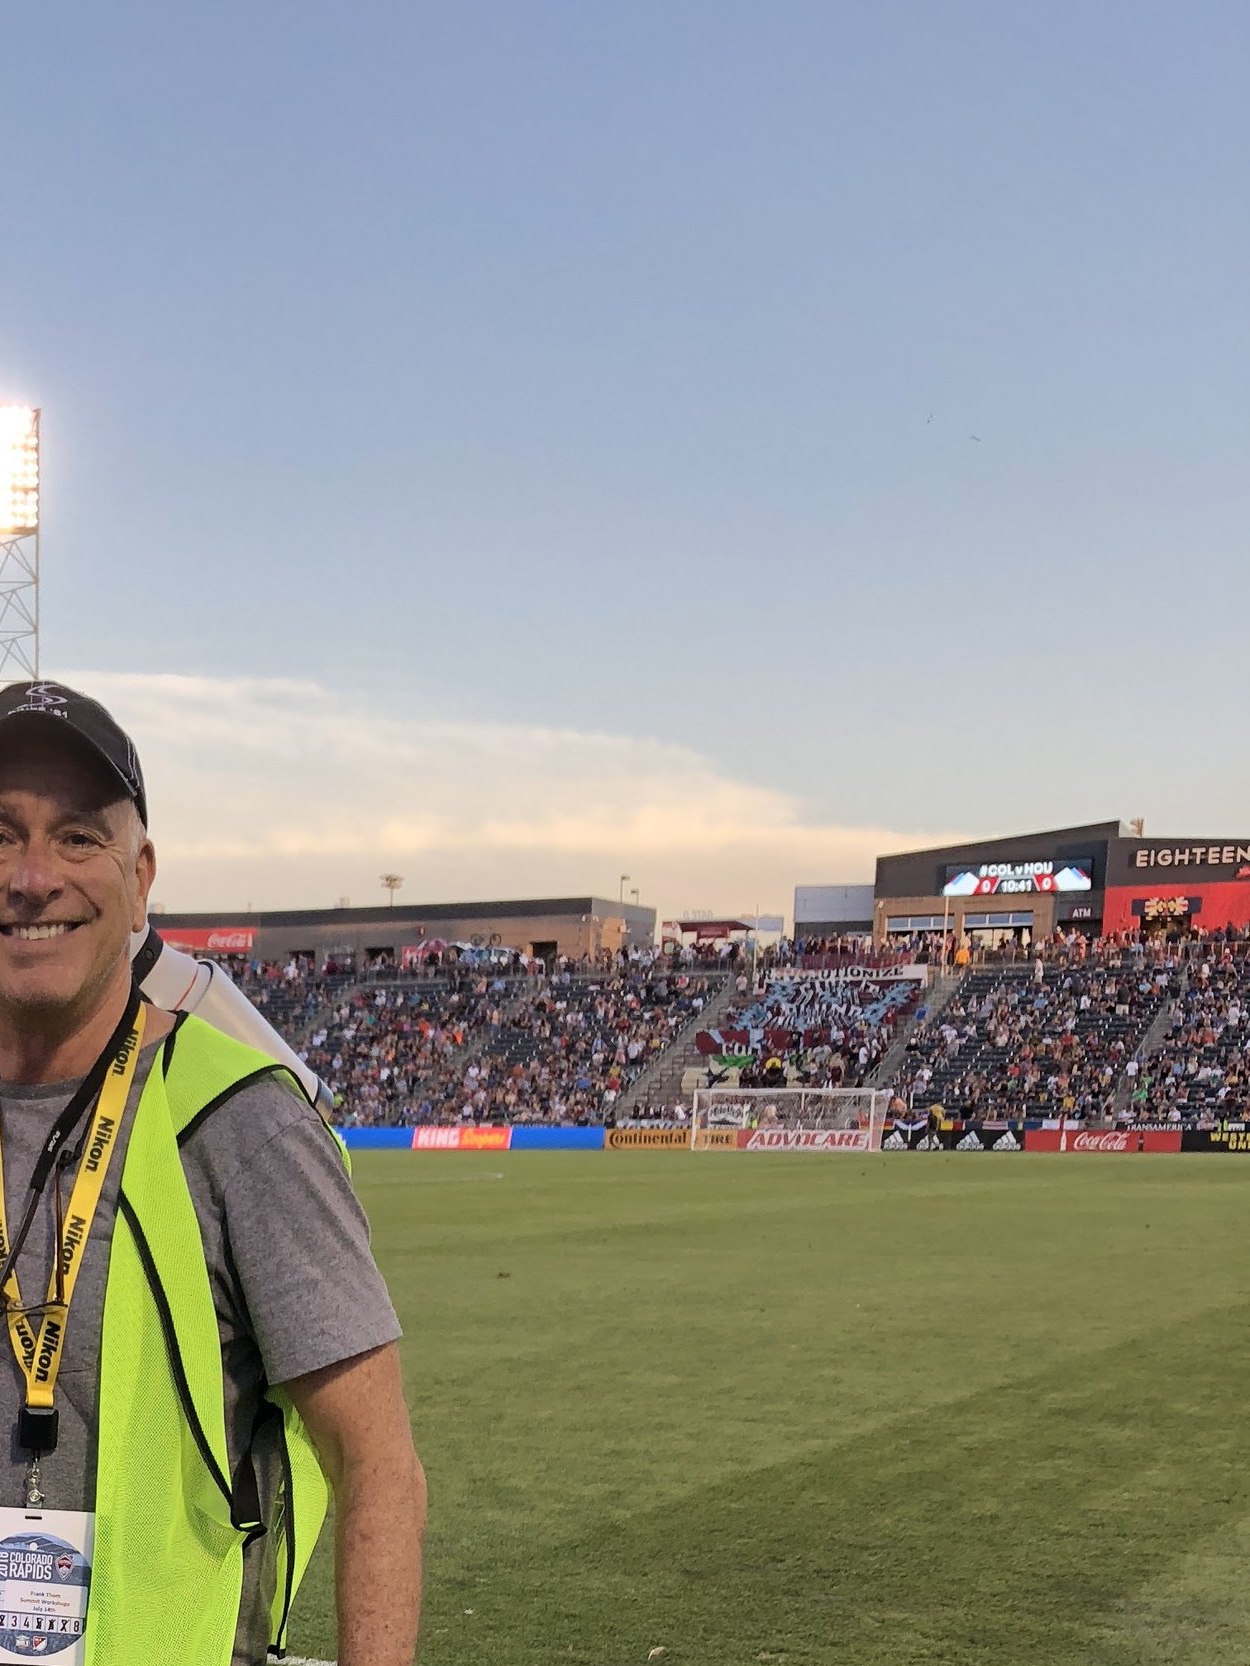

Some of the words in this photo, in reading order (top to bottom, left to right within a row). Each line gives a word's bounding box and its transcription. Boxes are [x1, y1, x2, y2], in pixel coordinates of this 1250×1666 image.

[1135, 845, 1250, 868] EIGHTEEN
[981, 879, 992, 893] 0
[1041, 876, 1052, 891] 0
[1071, 907, 1092, 920] ATM
[85, 1116, 116, 1174] Nikon
[417, 1128, 460, 1148] KING
[609, 1131, 687, 1148] Continental
[750, 1129, 868, 1148] ADVOCARE
[34, 1319, 62, 1384] Nikon
[10, 1551, 53, 1565] COLORADO
[9, 1563, 52, 1580] RAPIDS
[11, 1615, 17, 1627] 3
[23, 1616, 30, 1628] 4
